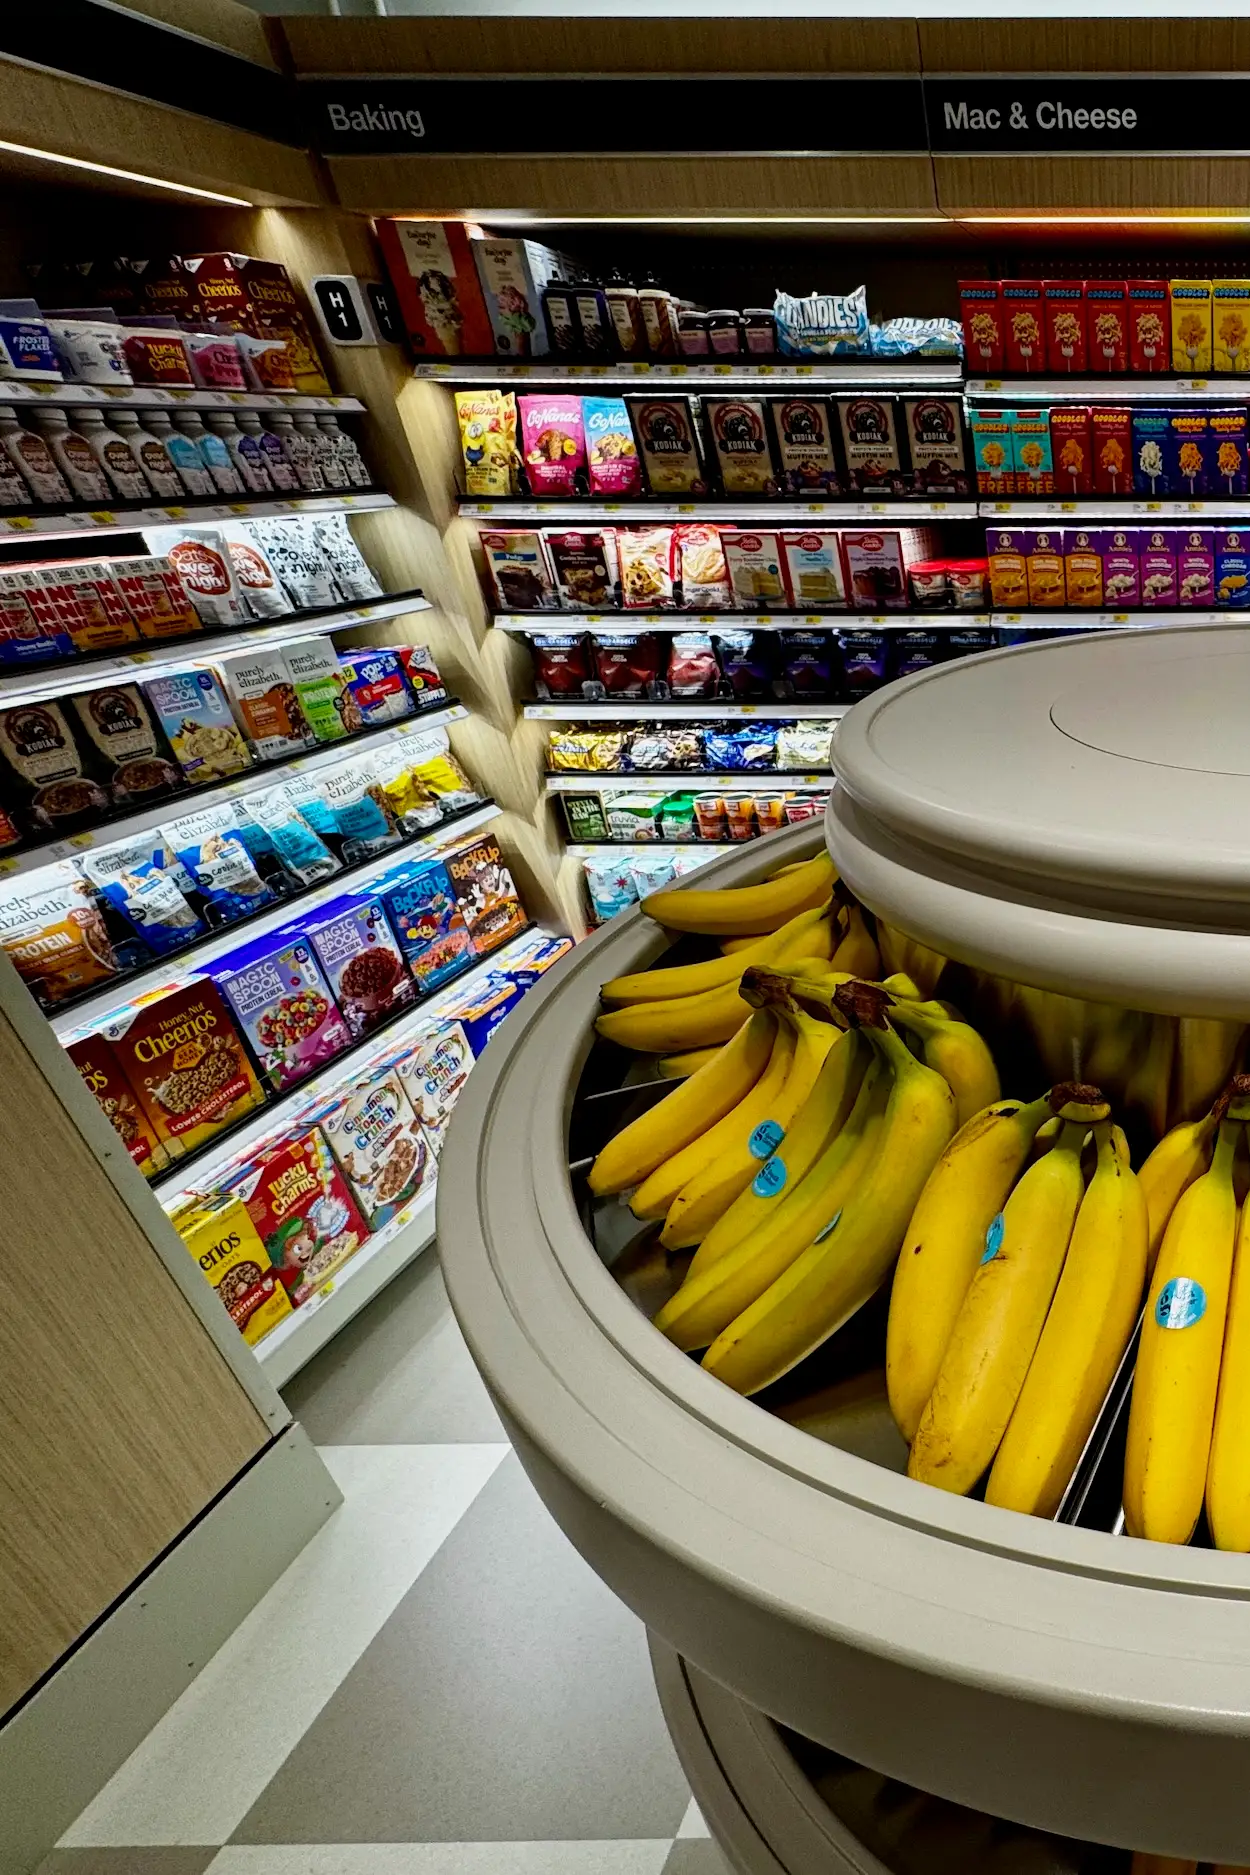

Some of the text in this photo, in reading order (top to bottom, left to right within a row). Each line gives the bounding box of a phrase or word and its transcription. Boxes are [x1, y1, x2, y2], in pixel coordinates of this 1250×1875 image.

[329, 104, 424, 136] Baking
[944, 102, 1137, 129] Mac & Cheese
[145, 284, 188, 299] Cheerios
[198, 282, 242, 297] Cheerios
[329, 292, 344, 307] H
[338, 313, 348, 327] 1
[527, 410, 580, 429] GoNanas
[653, 440, 684, 450] KODIAK
[727, 440, 757, 450] KODIAK
[792, 433, 817, 442] KODIAK
[857, 432, 882, 441] KODIAK
[923, 432, 949, 441] KODIAK
[978, 481, 1016, 493] FREE
[1017, 481, 1054, 493] FREE
[168, 549, 210, 562] Oats
[176, 562, 216, 574] over
[292, 562, 327, 575] night
[336, 560, 365, 574] night
[182, 574, 226, 590] night
[290, 653, 316, 667] purely
[293, 660, 333, 674] elizabeth.
[235, 665, 264, 681] purely
[239, 672, 283, 688] elizabeth.
[149, 678, 193, 693] MAGIC
[156, 688, 198, 706] SPOON
[110, 718, 137, 733] KODIAK
[26, 737, 58, 753] KODIAK
[398, 735, 425, 749] urely
[0, 897, 32, 916] rely
[315, 919, 356, 946] MAGIC
[8, 931, 74, 959] PROTEIN
[320, 928, 360, 956] SPOON
[325, 940, 362, 963] PROTEIN CEREAL
[227, 962, 276, 994] MAGIC
[233, 972, 282, 1005] SPOON
[241, 986, 283, 1013] PROTEIN CEREAL
[158, 1001, 205, 1031] Honey Nut
[134, 1009, 217, 1063] Cheerios
[176, 1047, 204, 1068] HONEY
[178, 1047, 196, 1061] REAL
[416, 1040, 455, 1080] Cinnamon
[424, 1053, 462, 1096] Crunch
[426, 1053, 451, 1080] Toast
[171, 1080, 246, 1132] LOWER CHOLESTEROL
[343, 1087, 391, 1135] Cinnamon
[354, 1103, 387, 1134] Toast
[354, 1104, 396, 1151] Crunch
[268, 1161, 308, 1195] Lucky
[272, 1172, 318, 1216] Charms
[199, 1231, 242, 1272] erios
[231, 1289, 264, 1321] LESTEROL
